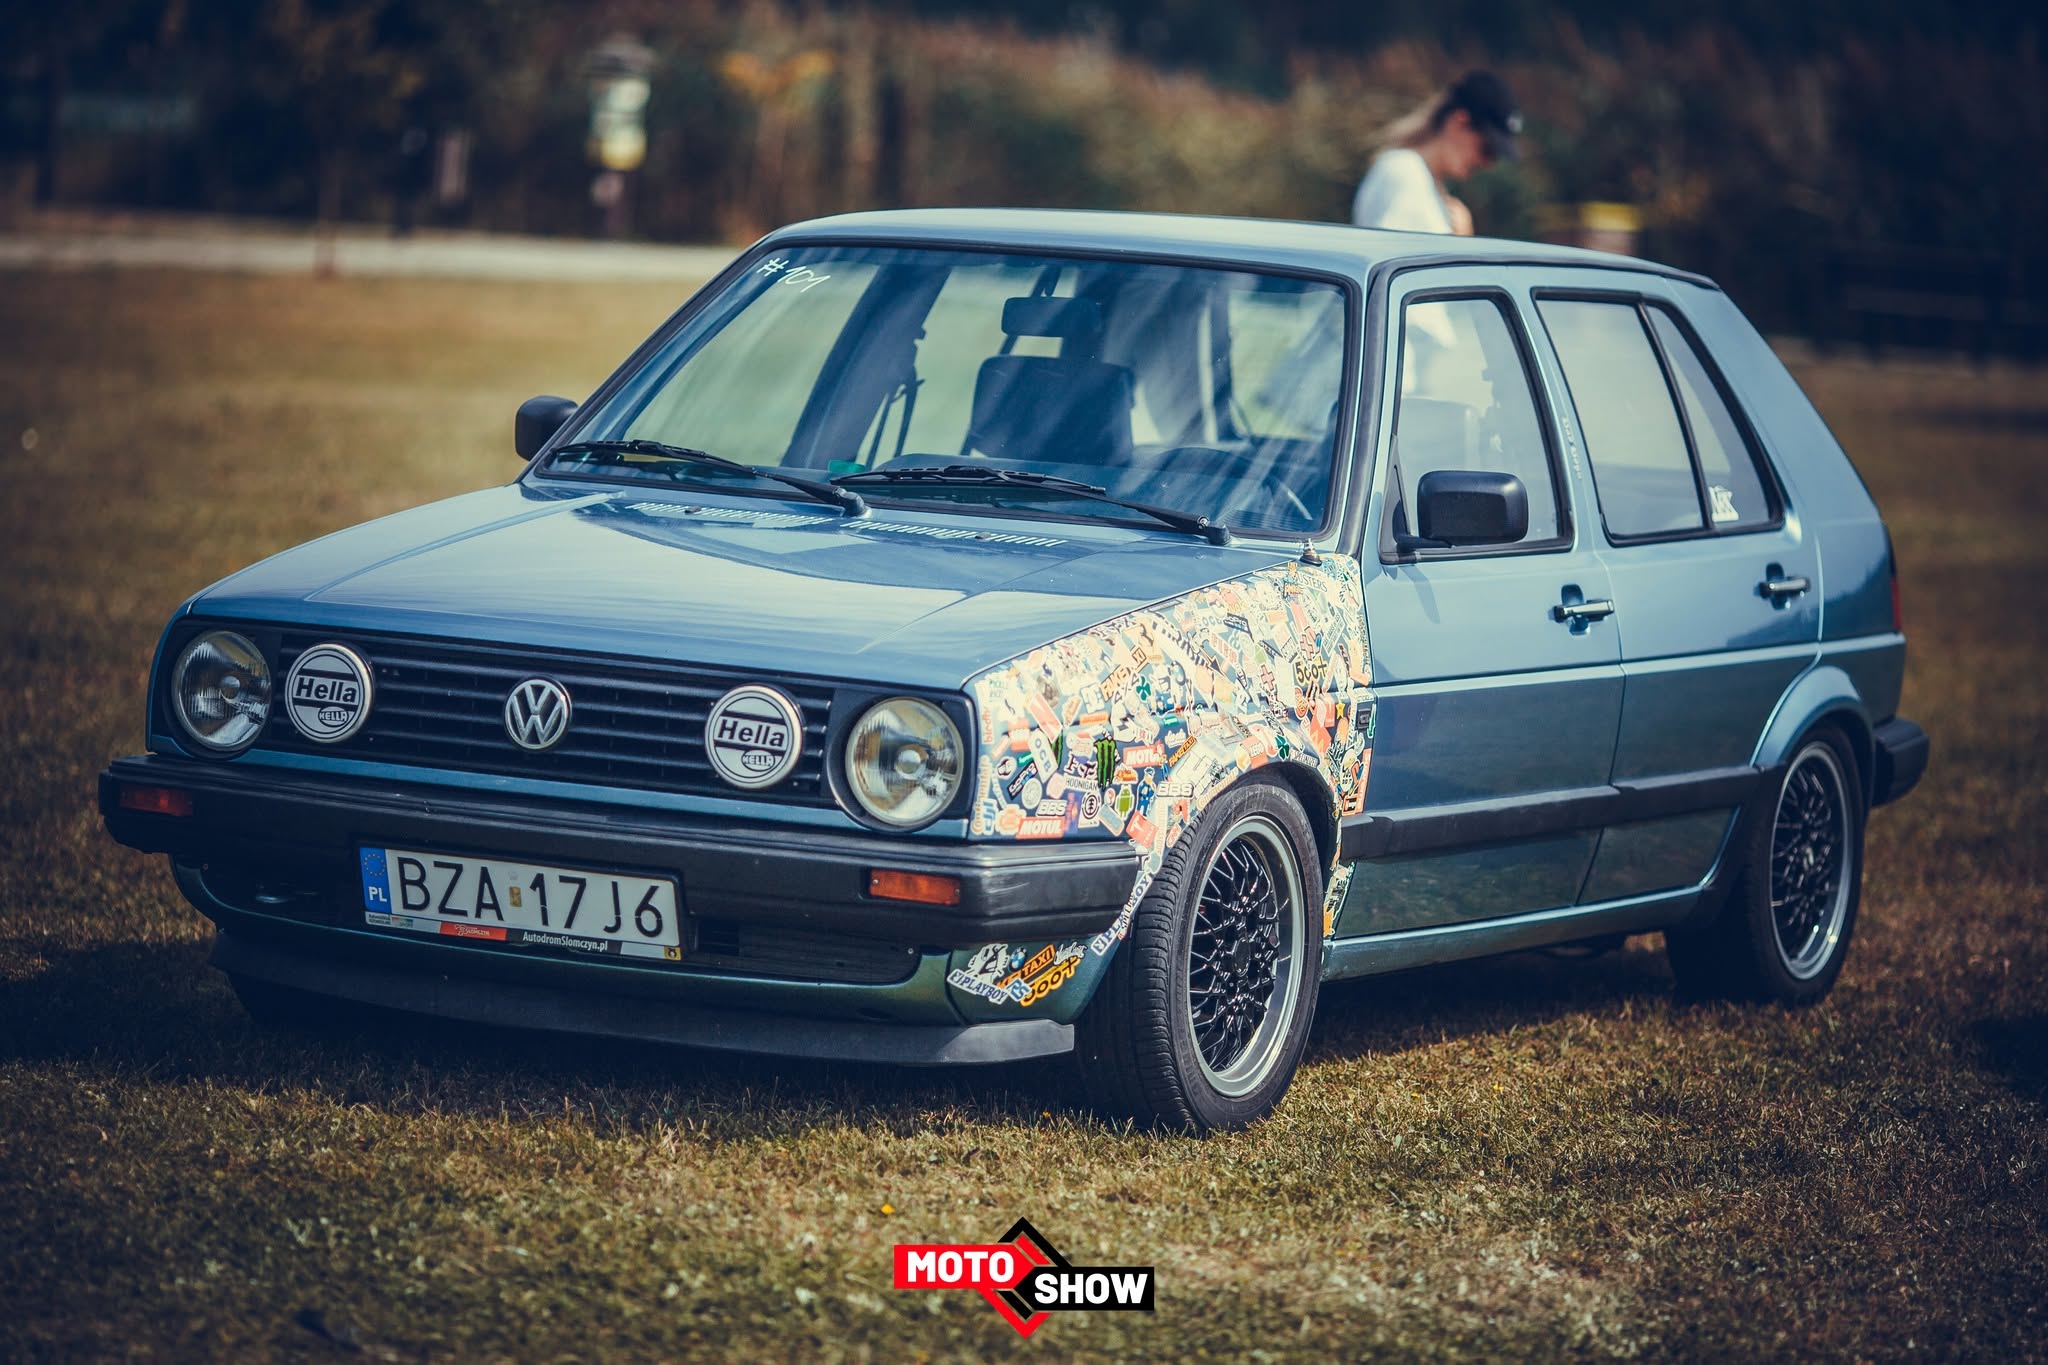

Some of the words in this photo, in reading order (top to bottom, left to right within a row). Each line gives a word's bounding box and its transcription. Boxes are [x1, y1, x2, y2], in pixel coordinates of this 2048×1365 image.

[296, 677, 357, 703] Hella
[319, 710, 348, 722] HELLA
[718, 719, 785, 747] Hella
[1126, 747, 1162, 766] MOTU
[1065, 777, 1098, 791] HOONIGAN
[1157, 782, 1195, 798] BBS
[1020, 818, 1064, 835] MOTUL
[368, 886, 387, 903] PL
[397, 856, 504, 922] BZA
[1021, 947, 1054, 977] TAXI
[961, 976, 1009, 1002] PLAYBOY
